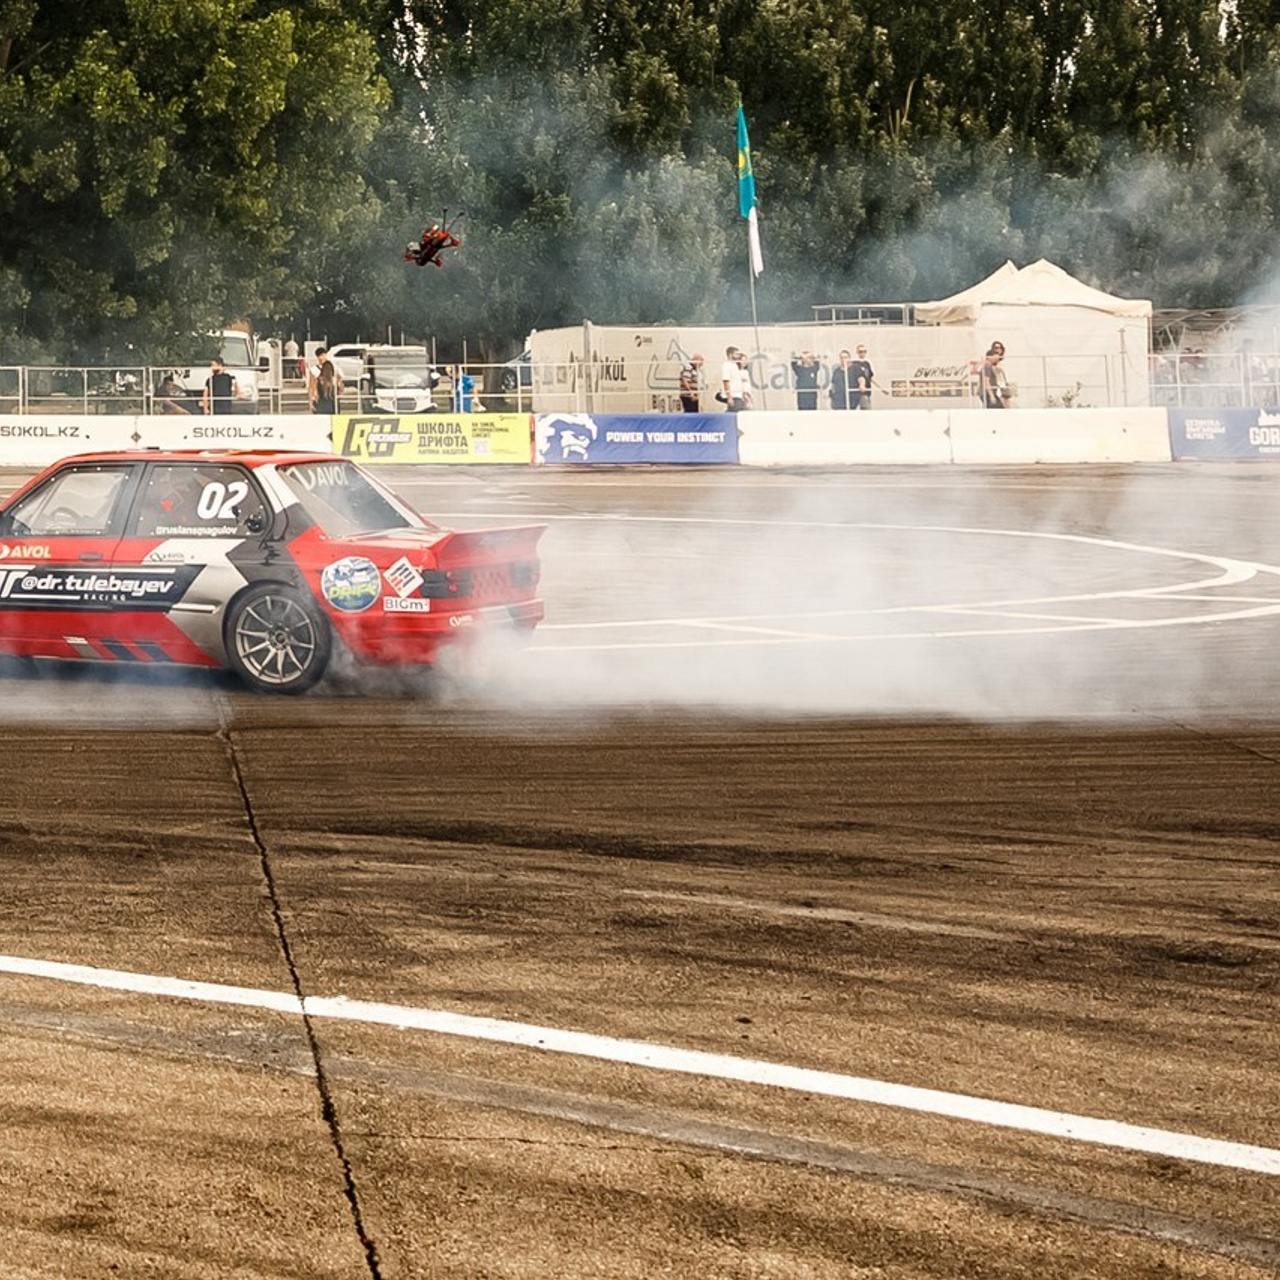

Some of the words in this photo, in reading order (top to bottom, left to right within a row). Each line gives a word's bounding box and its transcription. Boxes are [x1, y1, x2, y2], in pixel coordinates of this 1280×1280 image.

[0, 426, 80, 438] SOKOL.KZ
[193, 427, 274, 438] SOKOL.KZ
[417, 422, 462, 434] ШКОЛА
[418, 435, 468, 447] ДРИФТА
[606, 432, 644, 443] POWER
[646, 432, 675, 443] YOUR
[677, 432, 725, 443] INSTINCT
[197, 482, 249, 519] 02
[10, 546, 52, 558] AVOL
[21, 574, 173, 596] @dr.tulebayev
